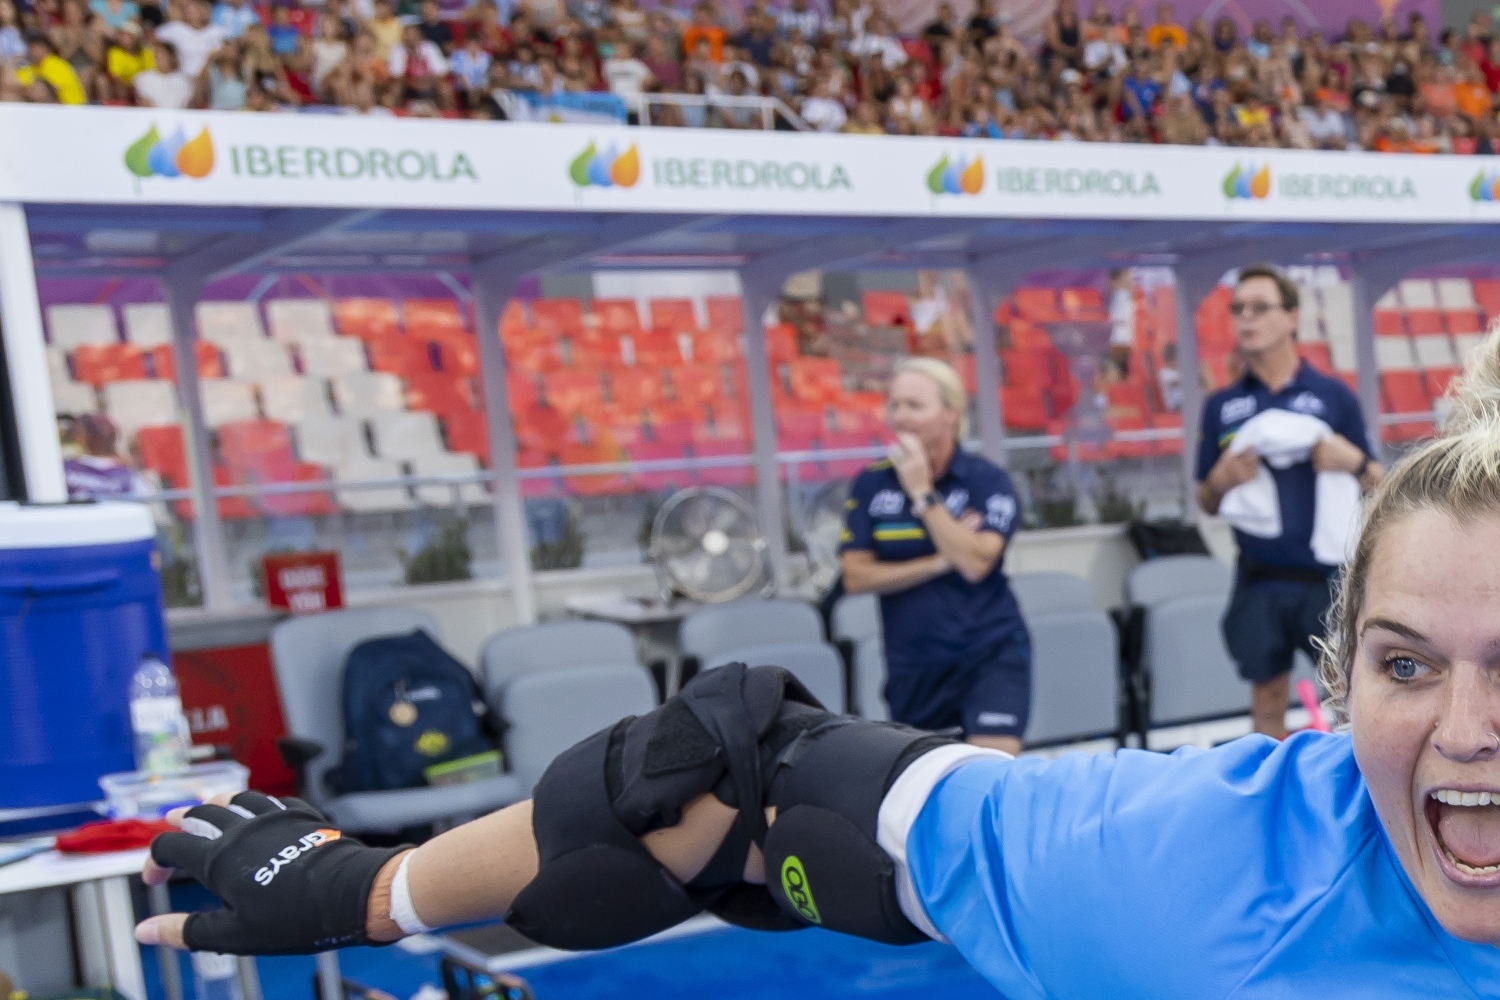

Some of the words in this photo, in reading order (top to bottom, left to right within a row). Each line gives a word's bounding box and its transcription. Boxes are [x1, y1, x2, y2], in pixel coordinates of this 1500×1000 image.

[229, 145, 478, 183] IBERDROLA
[652, 157, 853, 191] IBERDROLA
[997, 167, 1162, 198] IBERDROLA
[1279, 174, 1417, 201] IBERDROLA
